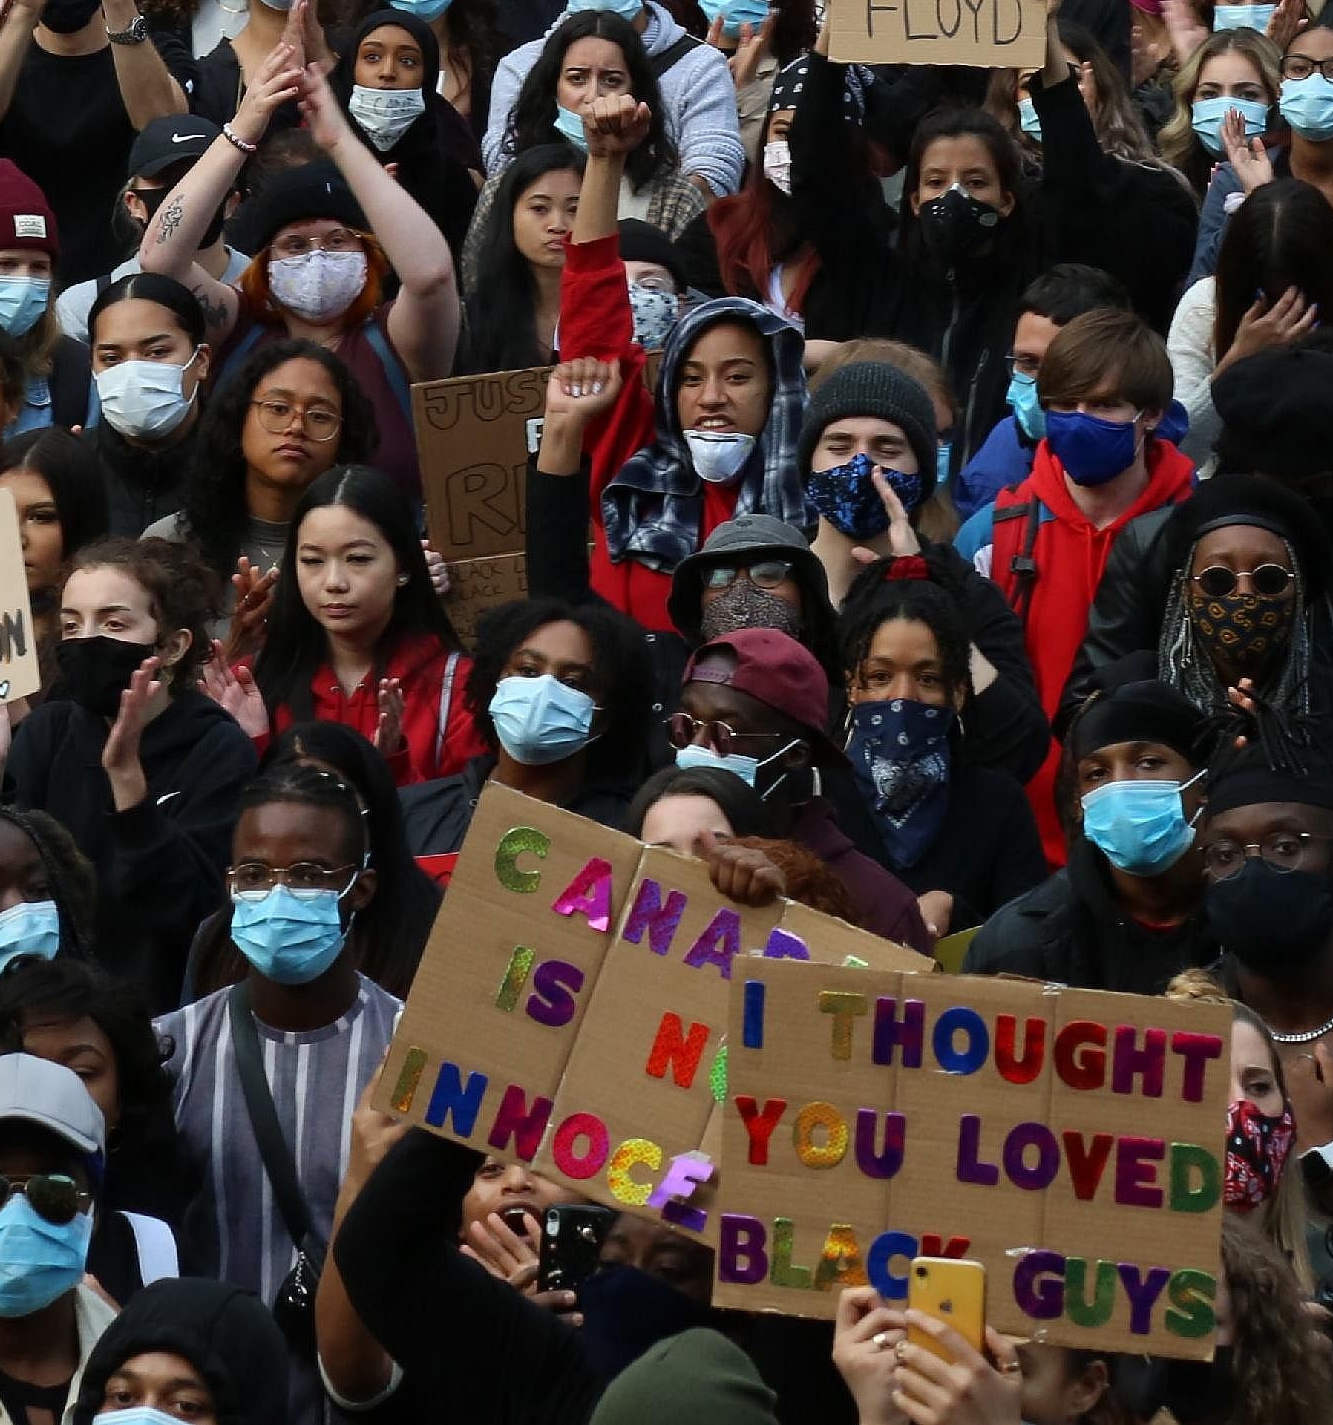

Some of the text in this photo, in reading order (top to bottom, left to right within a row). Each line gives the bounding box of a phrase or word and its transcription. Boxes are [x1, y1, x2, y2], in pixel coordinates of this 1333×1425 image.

[493, 944, 585, 1027] IS
[741, 981, 1224, 1103] I THOUGHT
[733, 1094, 1220, 1215] YOU LOVED
[1012, 1247, 1218, 1338] GUYS
